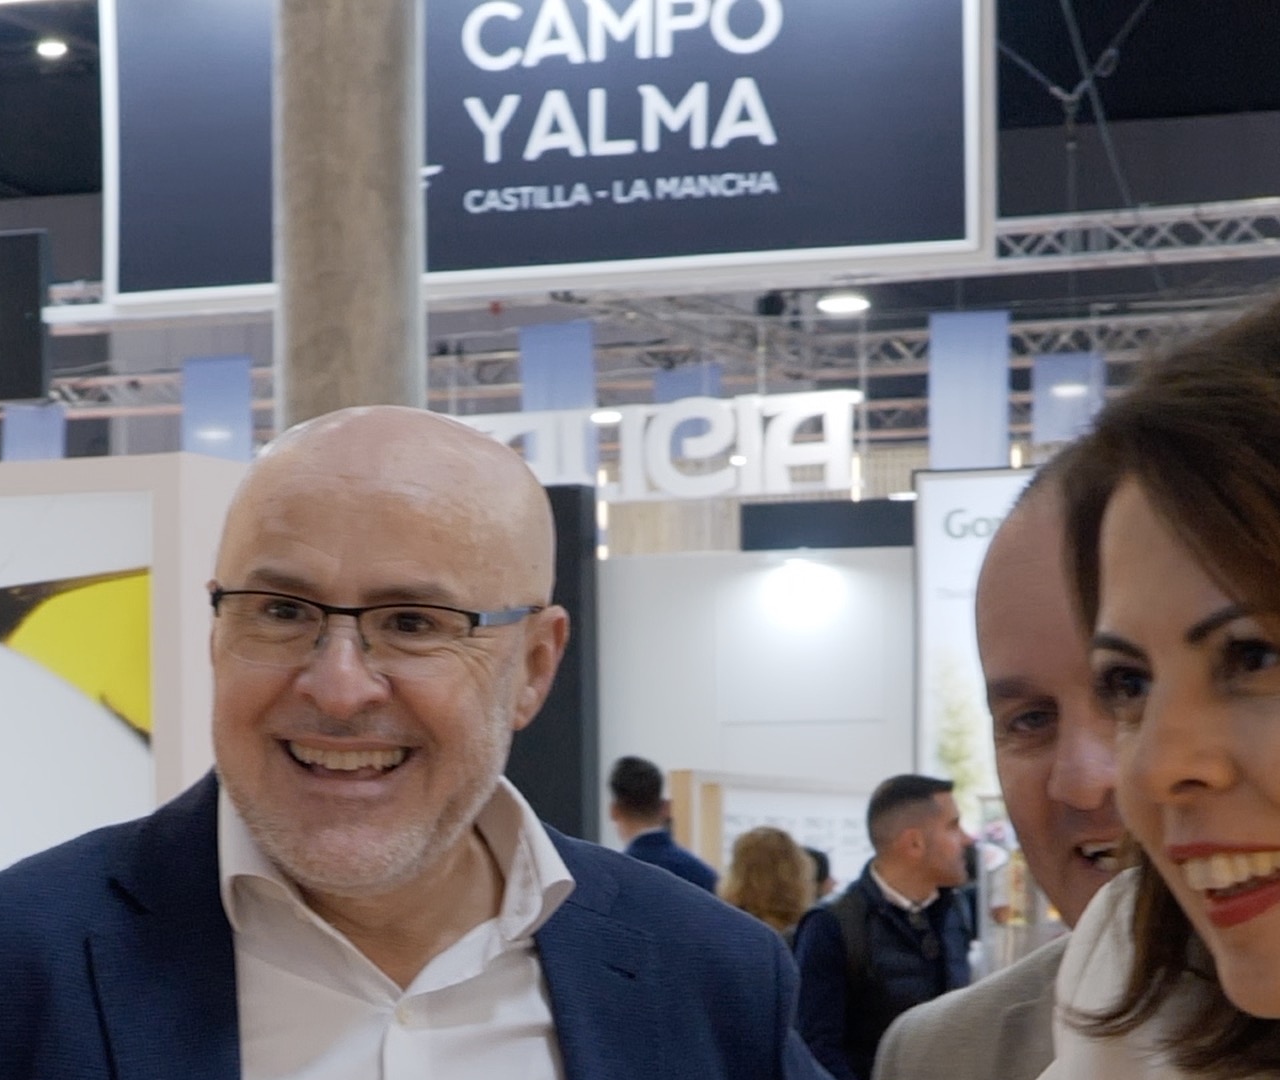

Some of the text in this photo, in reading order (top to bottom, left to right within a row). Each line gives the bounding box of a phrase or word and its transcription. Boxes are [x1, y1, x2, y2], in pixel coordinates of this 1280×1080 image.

[461, 0, 783, 71] CAMPO
[463, 183, 593, 213] CASTILLA
[612, 178, 652, 203] LA
[655, 171, 779, 200] MANCHA
